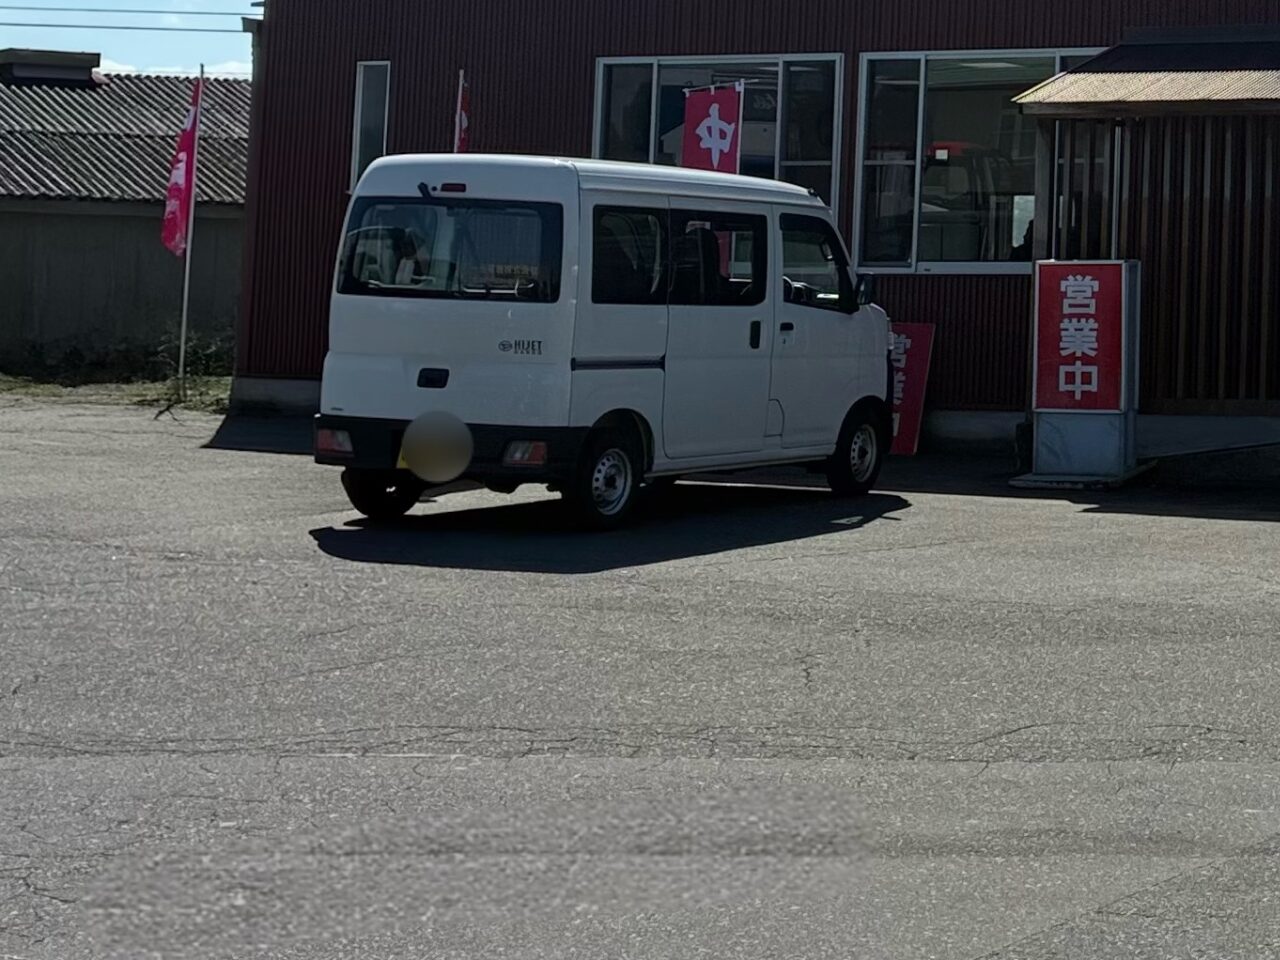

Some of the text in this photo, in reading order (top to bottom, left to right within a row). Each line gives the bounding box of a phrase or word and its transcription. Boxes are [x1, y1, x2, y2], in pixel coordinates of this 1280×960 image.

[514, 339, 543, 351] HIJET
[1059, 274, 1099, 401] 営業中
